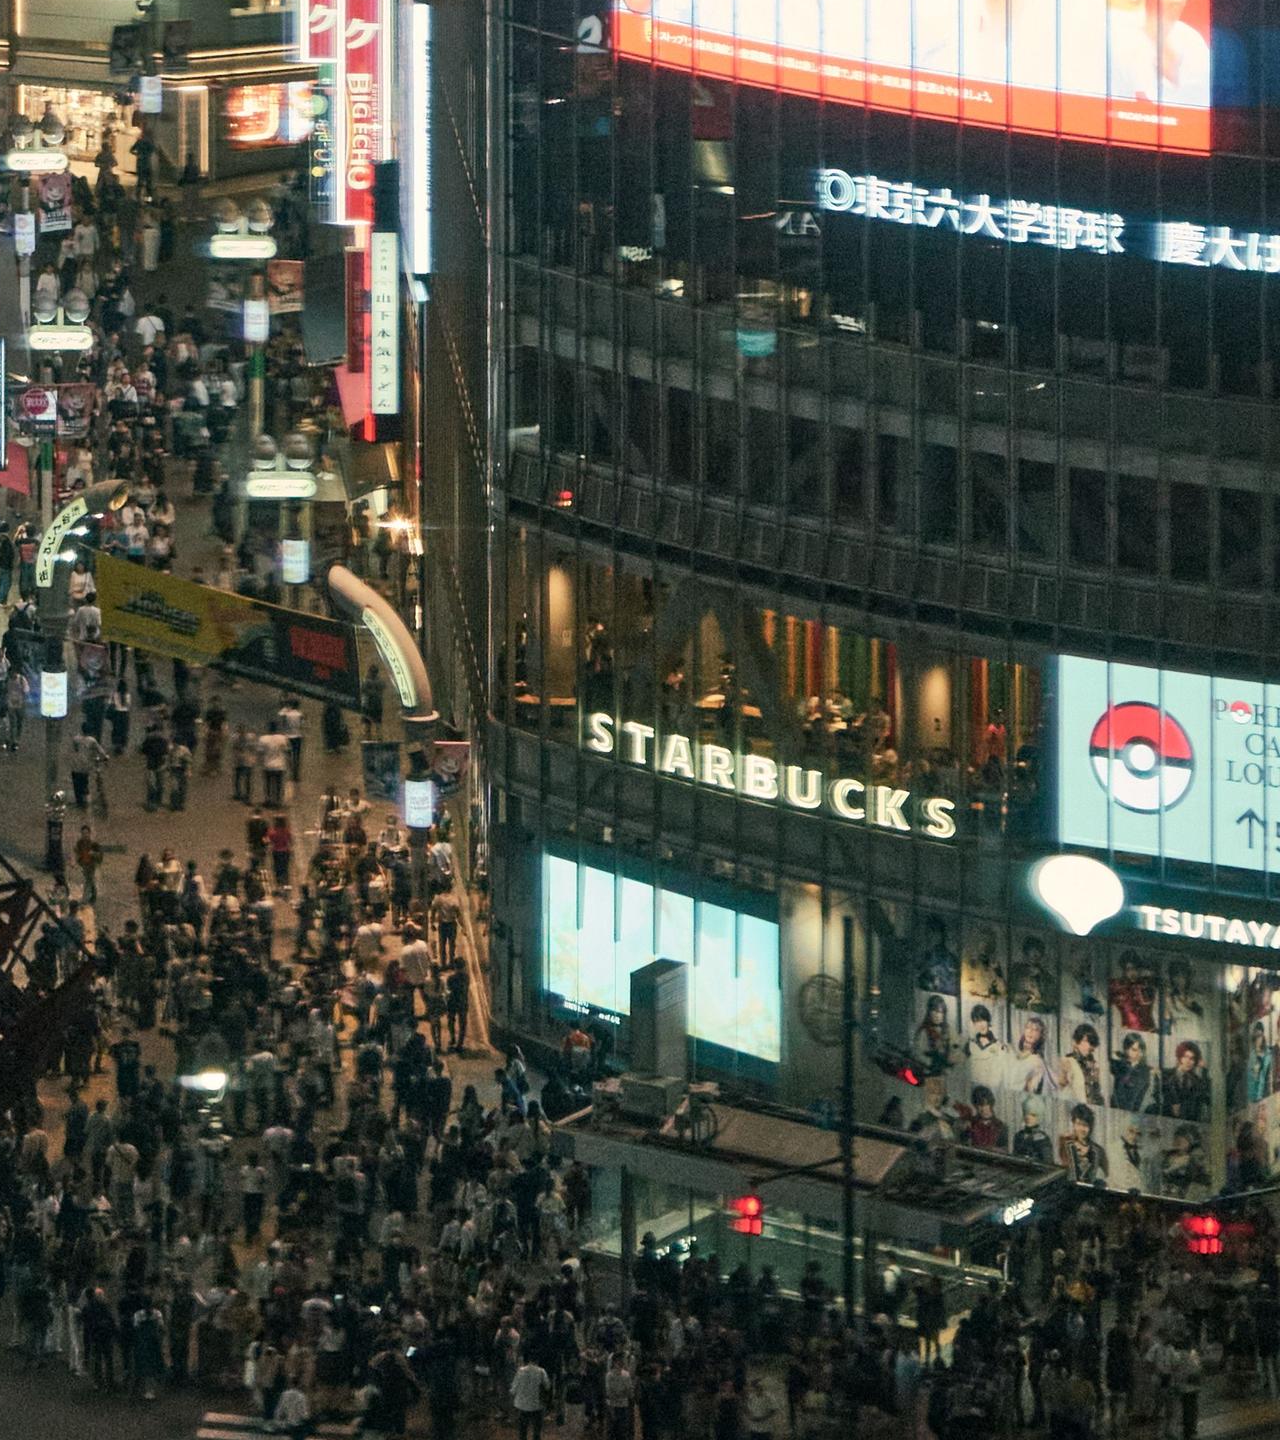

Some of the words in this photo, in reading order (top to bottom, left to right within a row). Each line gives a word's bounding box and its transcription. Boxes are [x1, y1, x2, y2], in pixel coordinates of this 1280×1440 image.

[376, 292, 392, 409] 山下本気うどん
[588, 711, 957, 840] STARBUCKS
